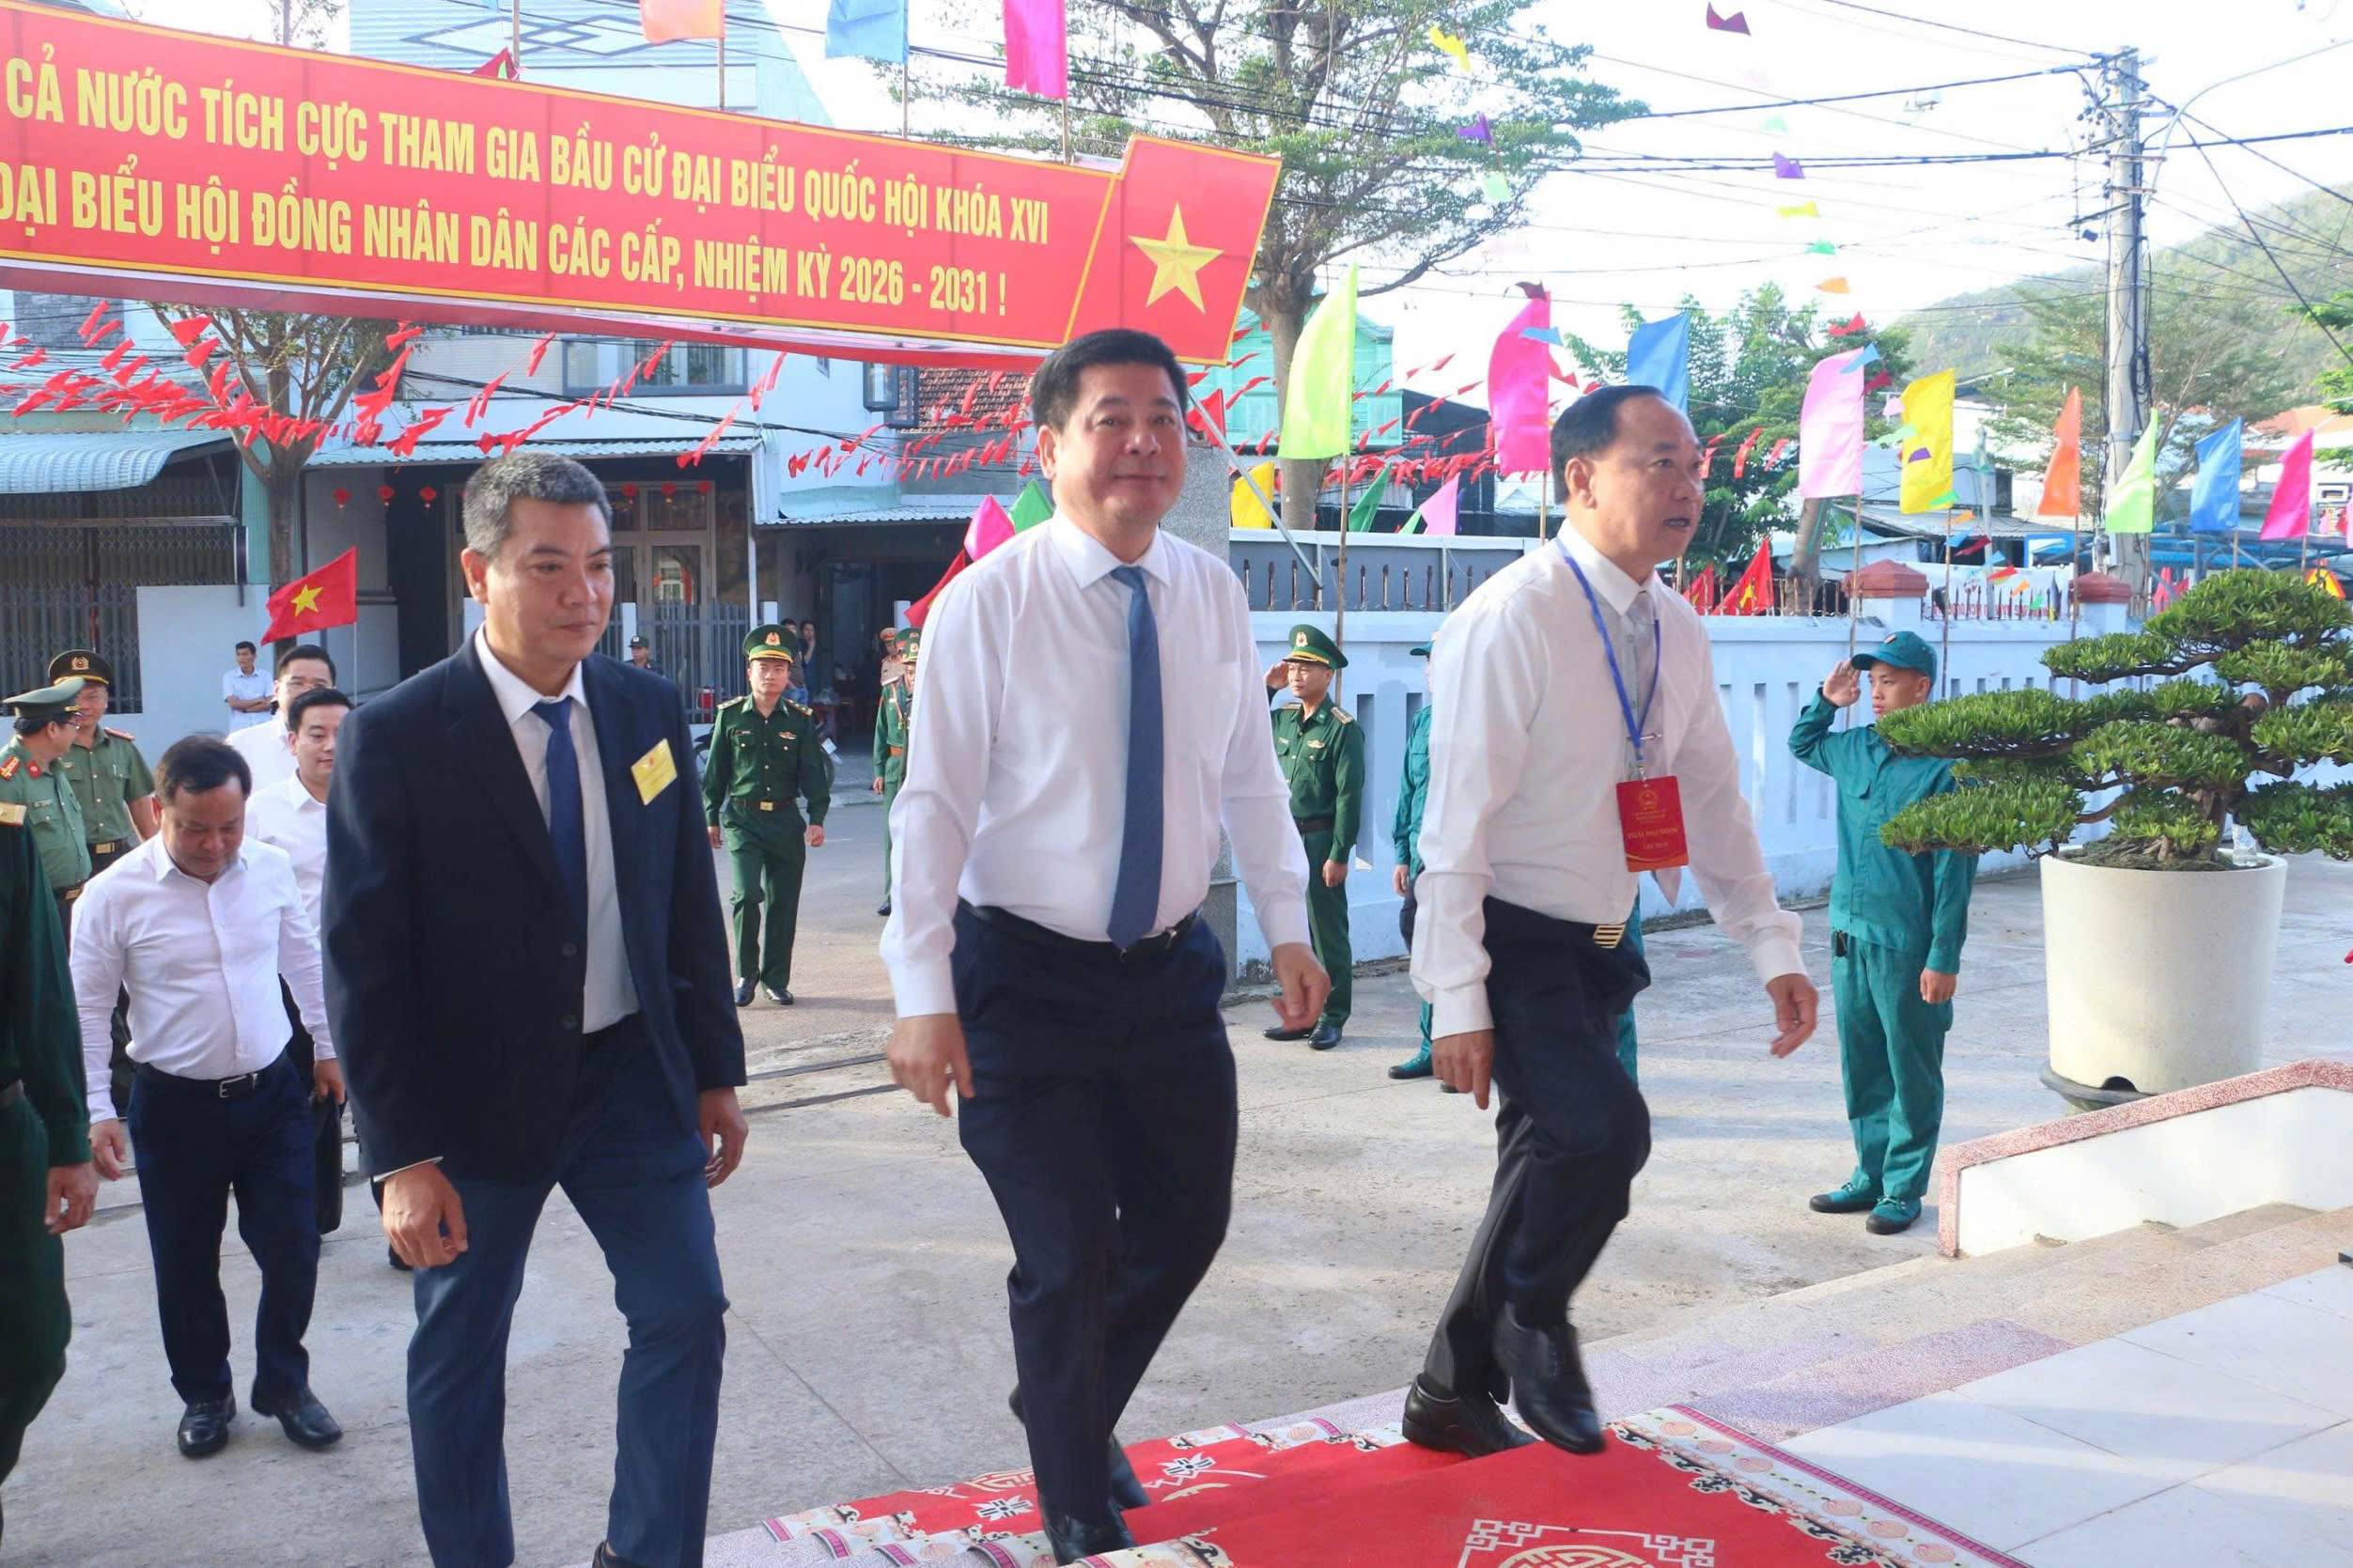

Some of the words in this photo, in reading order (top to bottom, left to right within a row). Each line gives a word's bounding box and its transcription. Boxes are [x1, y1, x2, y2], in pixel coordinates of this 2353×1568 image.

[6, 43, 64, 122] CẢ
[76, 67, 188, 140] NƯỚC
[200, 78, 284, 151] TÍCH
[297, 101, 368, 171] CỰC
[379, 112, 475, 175] THAM
[486, 127, 541, 183] GIA
[551, 120, 612, 192] BẦU
[622, 132, 667, 197] CỬ
[672, 154, 722, 215] ĐẠI
[731, 143, 796, 212] BIỂU
[804, 157, 876, 224] QUỐC
[884, 173, 928, 239] HỘI
[936, 184, 1004, 241] KHÓA
[1010, 197, 1049, 244] XVI
[71, 153, 164, 238] BIỂU
[177, 175, 241, 256] HỘI
[252, 177, 352, 257] ĐỒNG
[364, 198, 460, 265] NHÂN
[471, 207, 538, 272] DÂN
[549, 215, 611, 280] CÁC
[621, 217, 685, 292] CẤP,
[694, 235, 788, 303] NHIỆM
[797, 242, 832, 299] KỲ
[840, 256, 904, 307] 2026
[929, 264, 988, 314] 2031
[999, 274, 1006, 318] !
